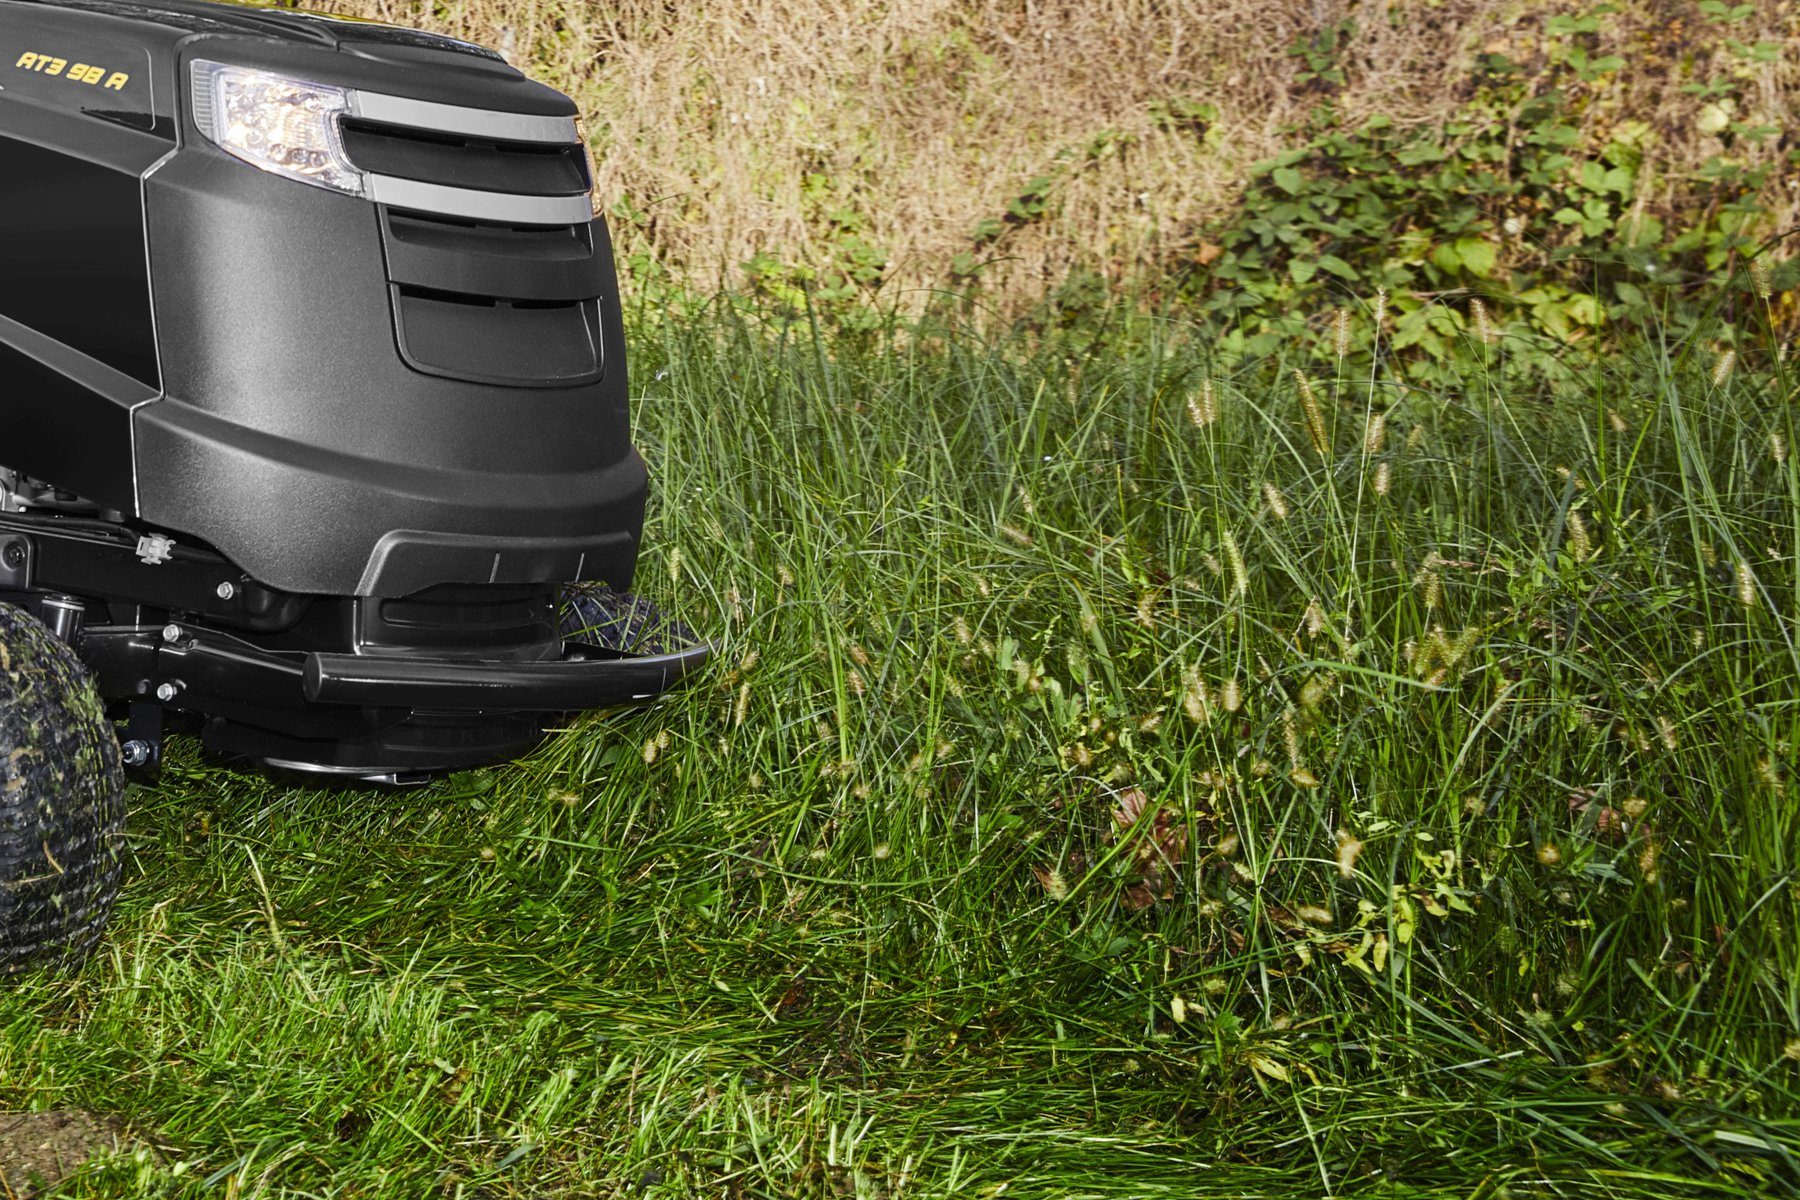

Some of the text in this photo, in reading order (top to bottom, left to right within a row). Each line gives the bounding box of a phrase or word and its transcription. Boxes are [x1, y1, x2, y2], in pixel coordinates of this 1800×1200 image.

[15, 51, 130, 91] AT3 98 A
